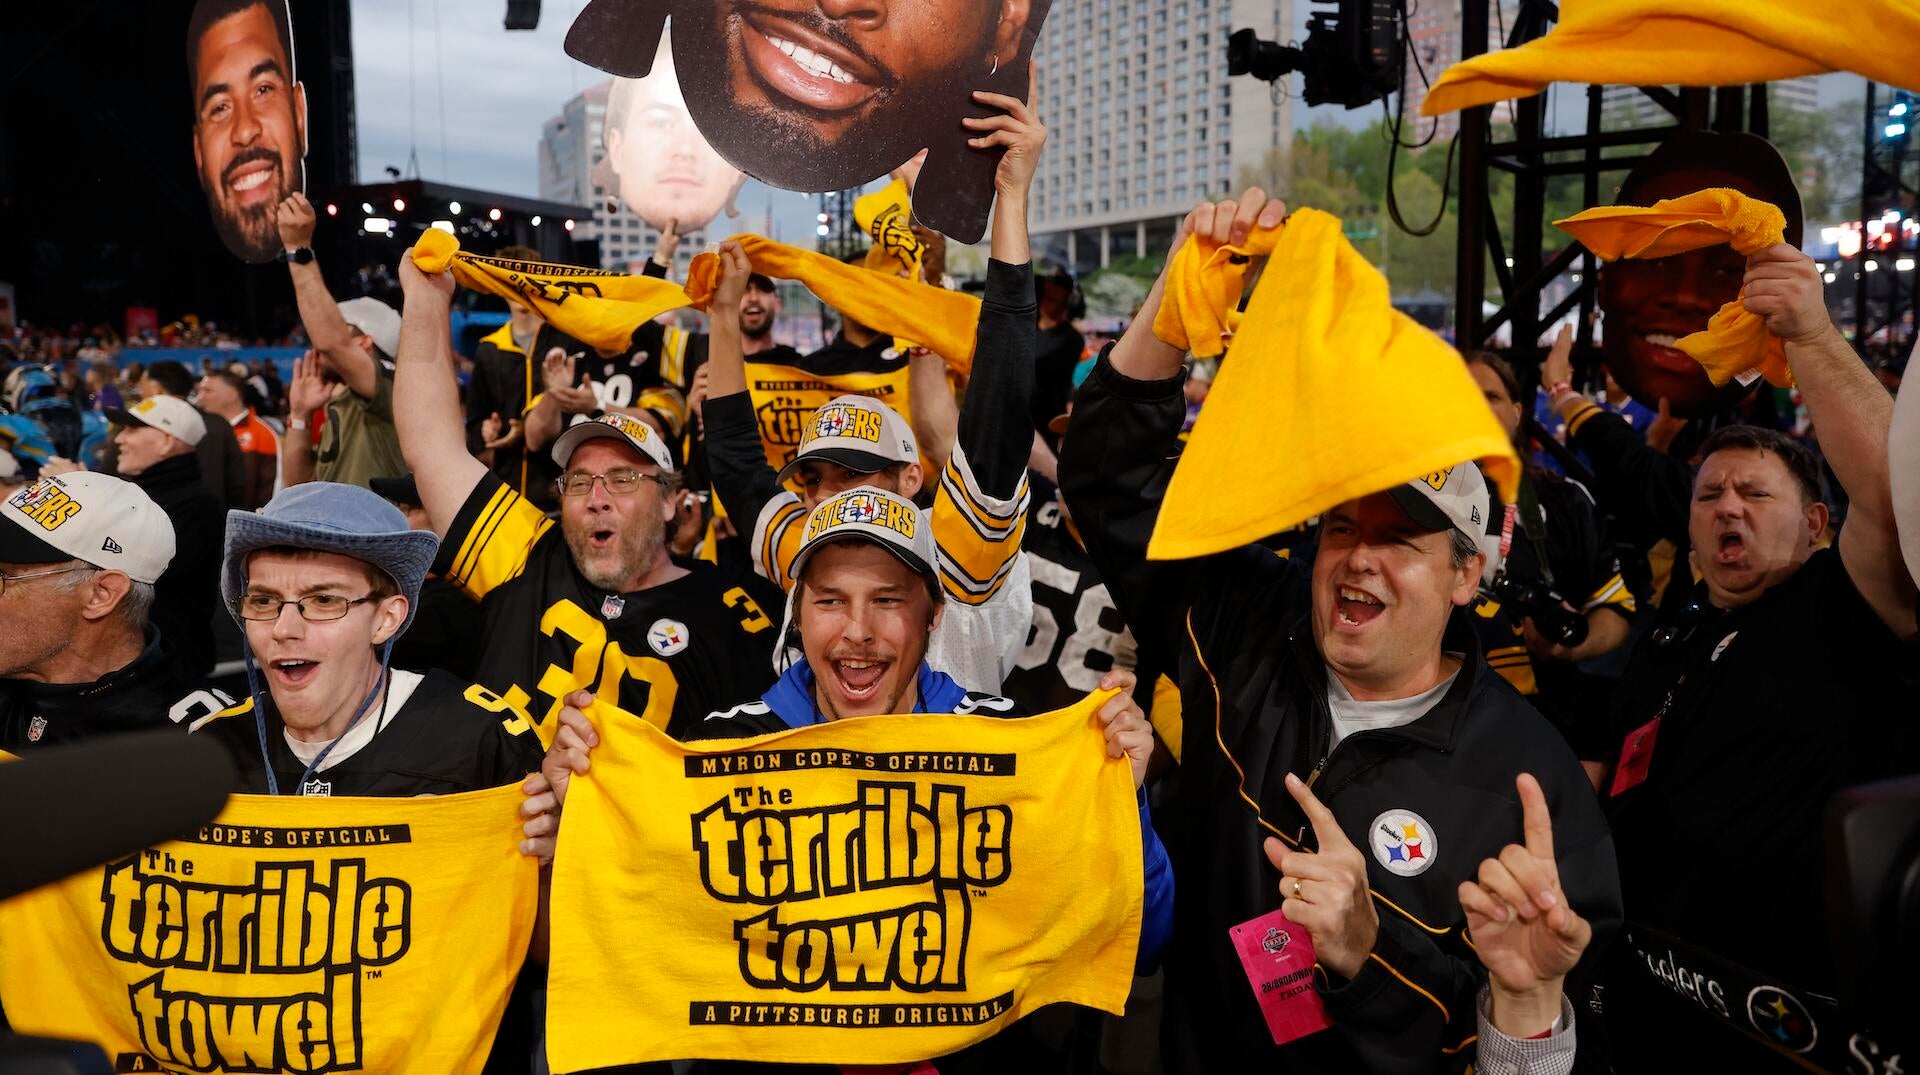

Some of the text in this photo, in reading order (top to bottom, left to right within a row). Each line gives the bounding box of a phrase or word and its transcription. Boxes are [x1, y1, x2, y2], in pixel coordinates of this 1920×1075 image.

[802, 407, 882, 445] STEELERS
[807, 494, 916, 542] STEELERS
[1010, 550, 1139, 693] 58
[702, 751, 995, 774] MYRON COPE'S OFFICIAL
[734, 786, 793, 807] The
[286, 828, 391, 846] OFFICIAL
[690, 779, 1013, 905] terrible
[145, 851, 195, 876] The
[101, 857, 412, 974] terrible
[733, 880, 972, 993] towel
[127, 965, 363, 1075] towel
[705, 1001, 1003, 1025] A PITTSBURGH ORIGINAL
